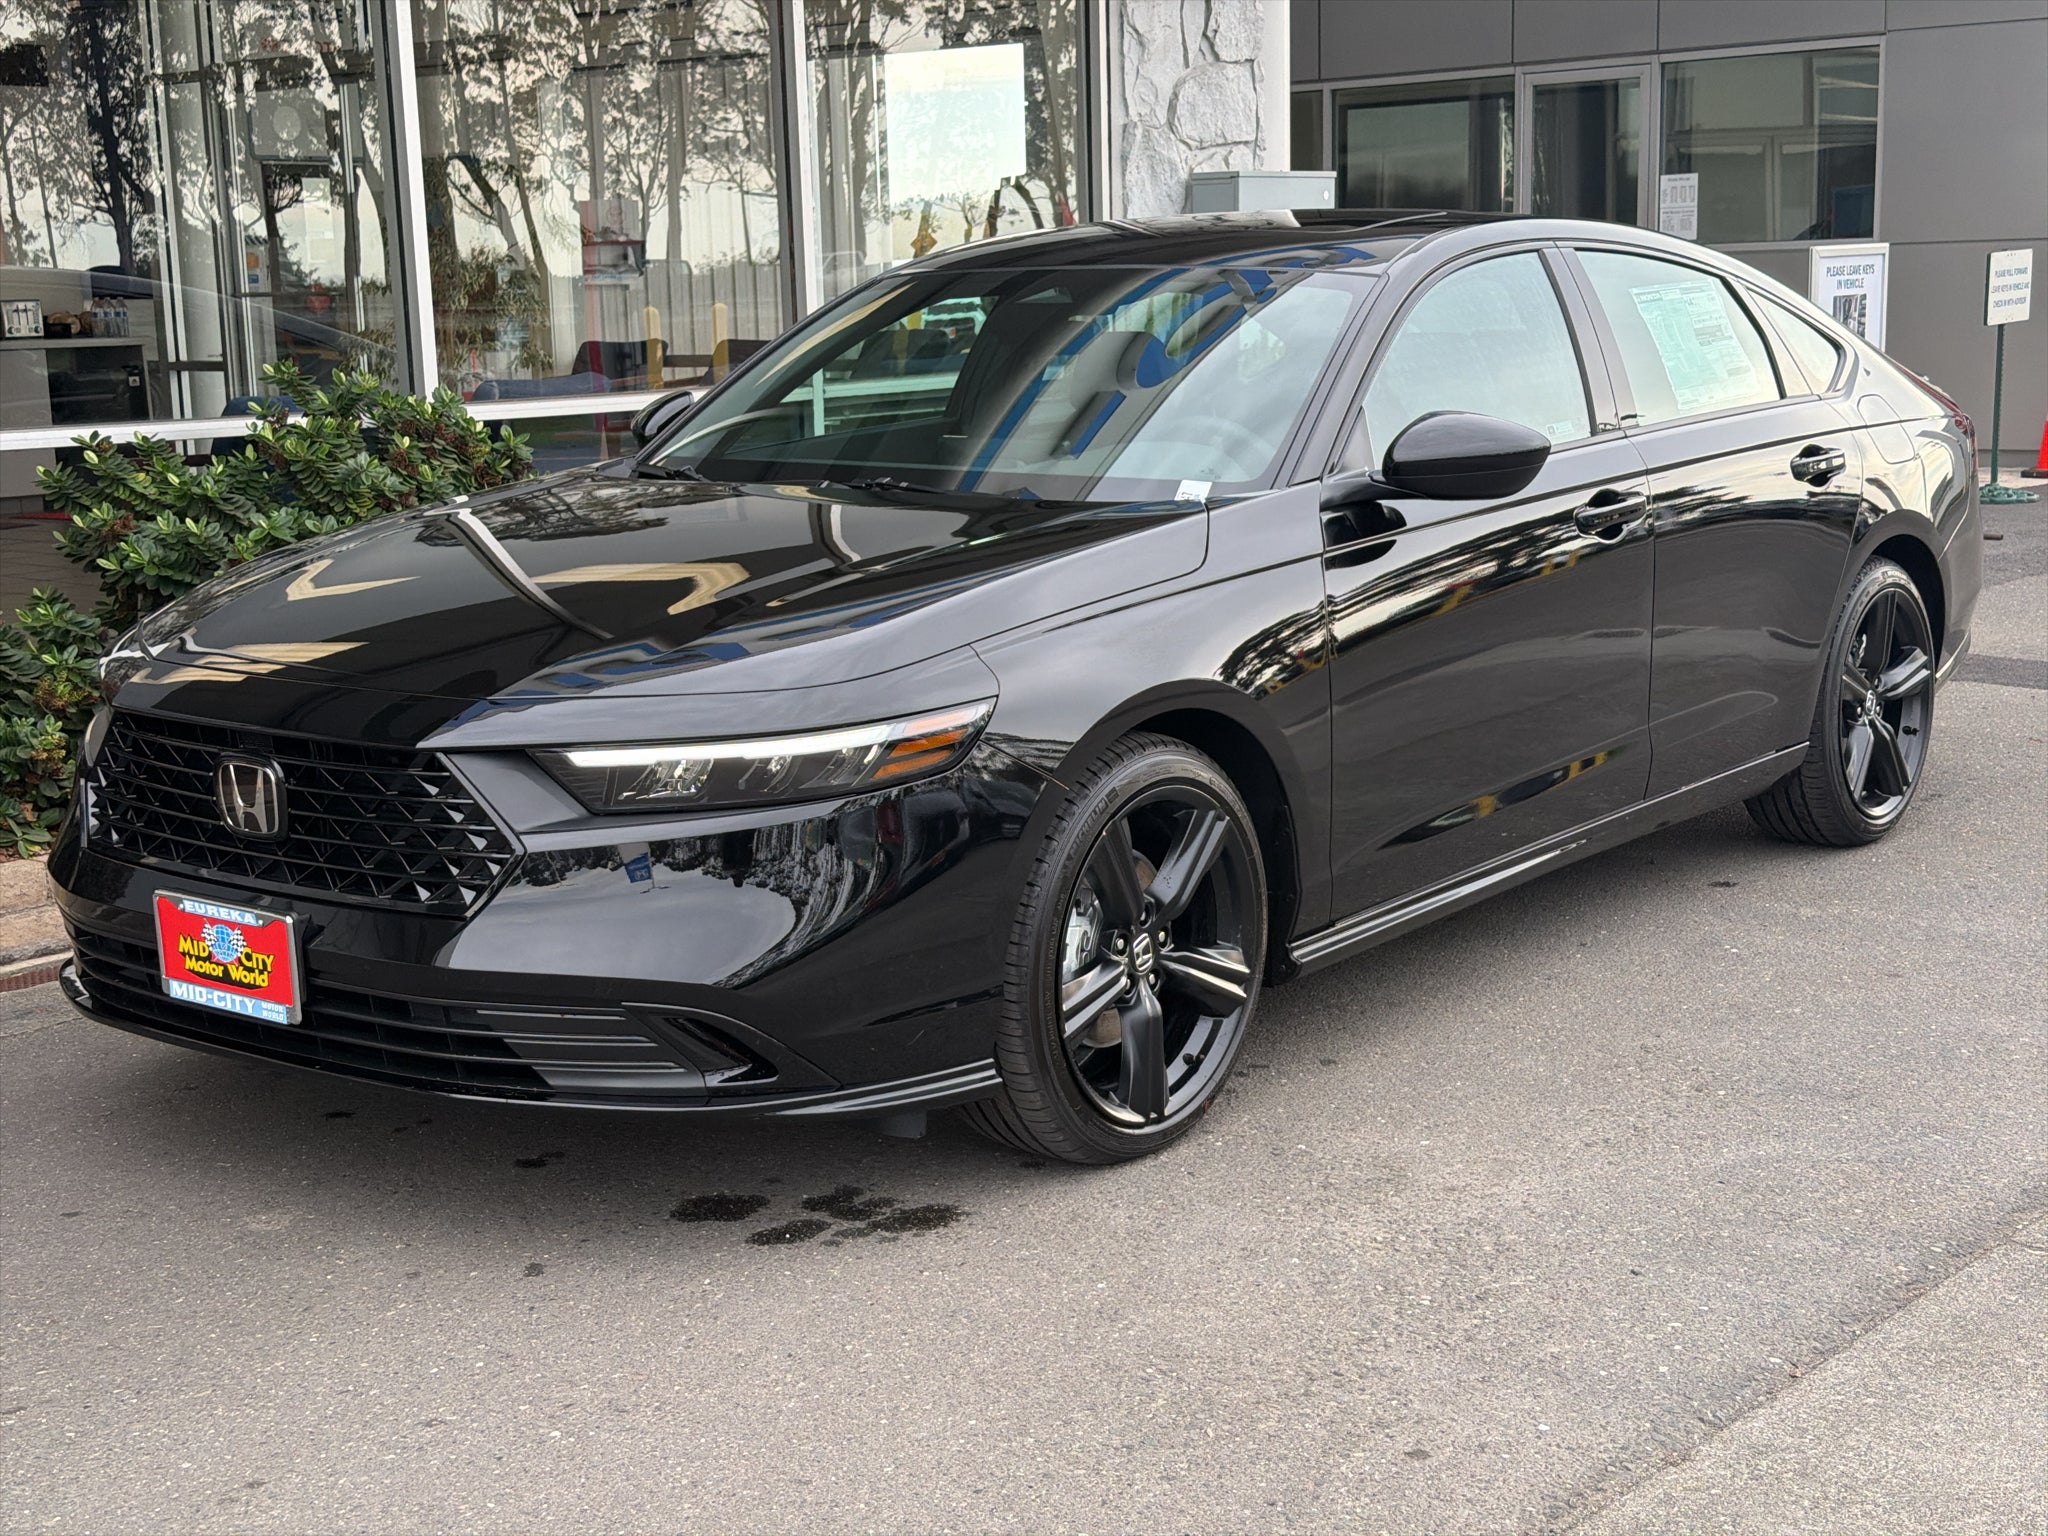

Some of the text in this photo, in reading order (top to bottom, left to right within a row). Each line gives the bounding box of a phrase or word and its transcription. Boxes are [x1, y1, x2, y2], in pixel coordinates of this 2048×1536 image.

[1826, 264, 1875, 277] PLEASE LEAVE KEYS
[1836, 278, 1865, 290] IN VEHICLE
[184, 901, 256, 924] EUREKA
[178, 934, 274, 972] MID CITY
[184, 954, 269, 987] Motor World
[172, 981, 257, 1014] MID-CITY
[261, 1001, 284, 1013] MOTOR
[262, 1010, 284, 1021] WORLD
